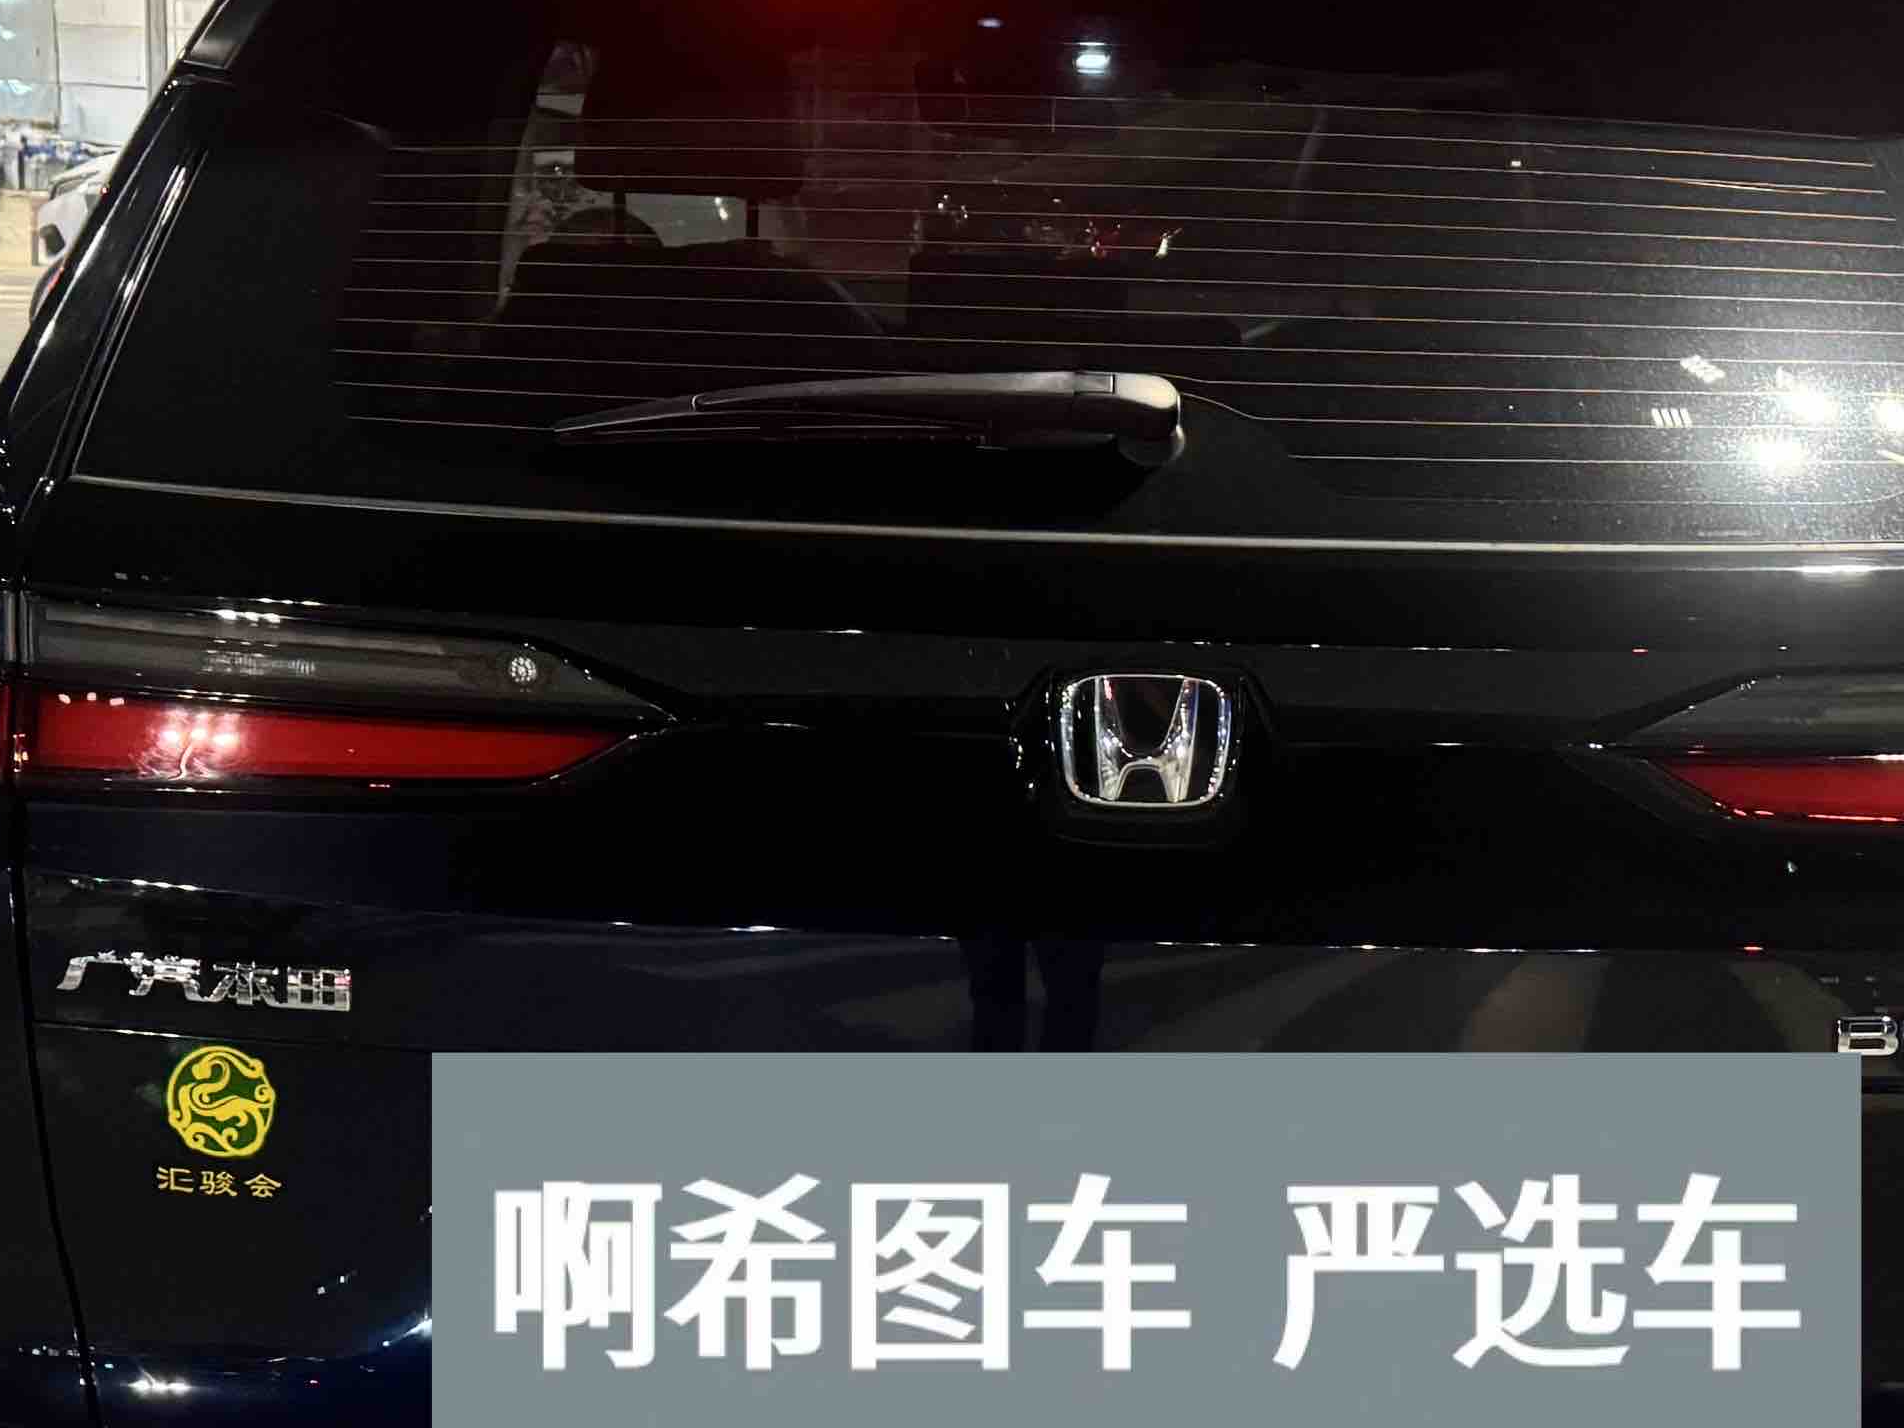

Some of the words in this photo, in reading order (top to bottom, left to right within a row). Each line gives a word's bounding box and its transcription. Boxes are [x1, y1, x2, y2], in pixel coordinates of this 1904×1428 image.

[56, 950, 352, 1012] 广汽本田
[156, 1166, 282, 1198] 汇骏会
